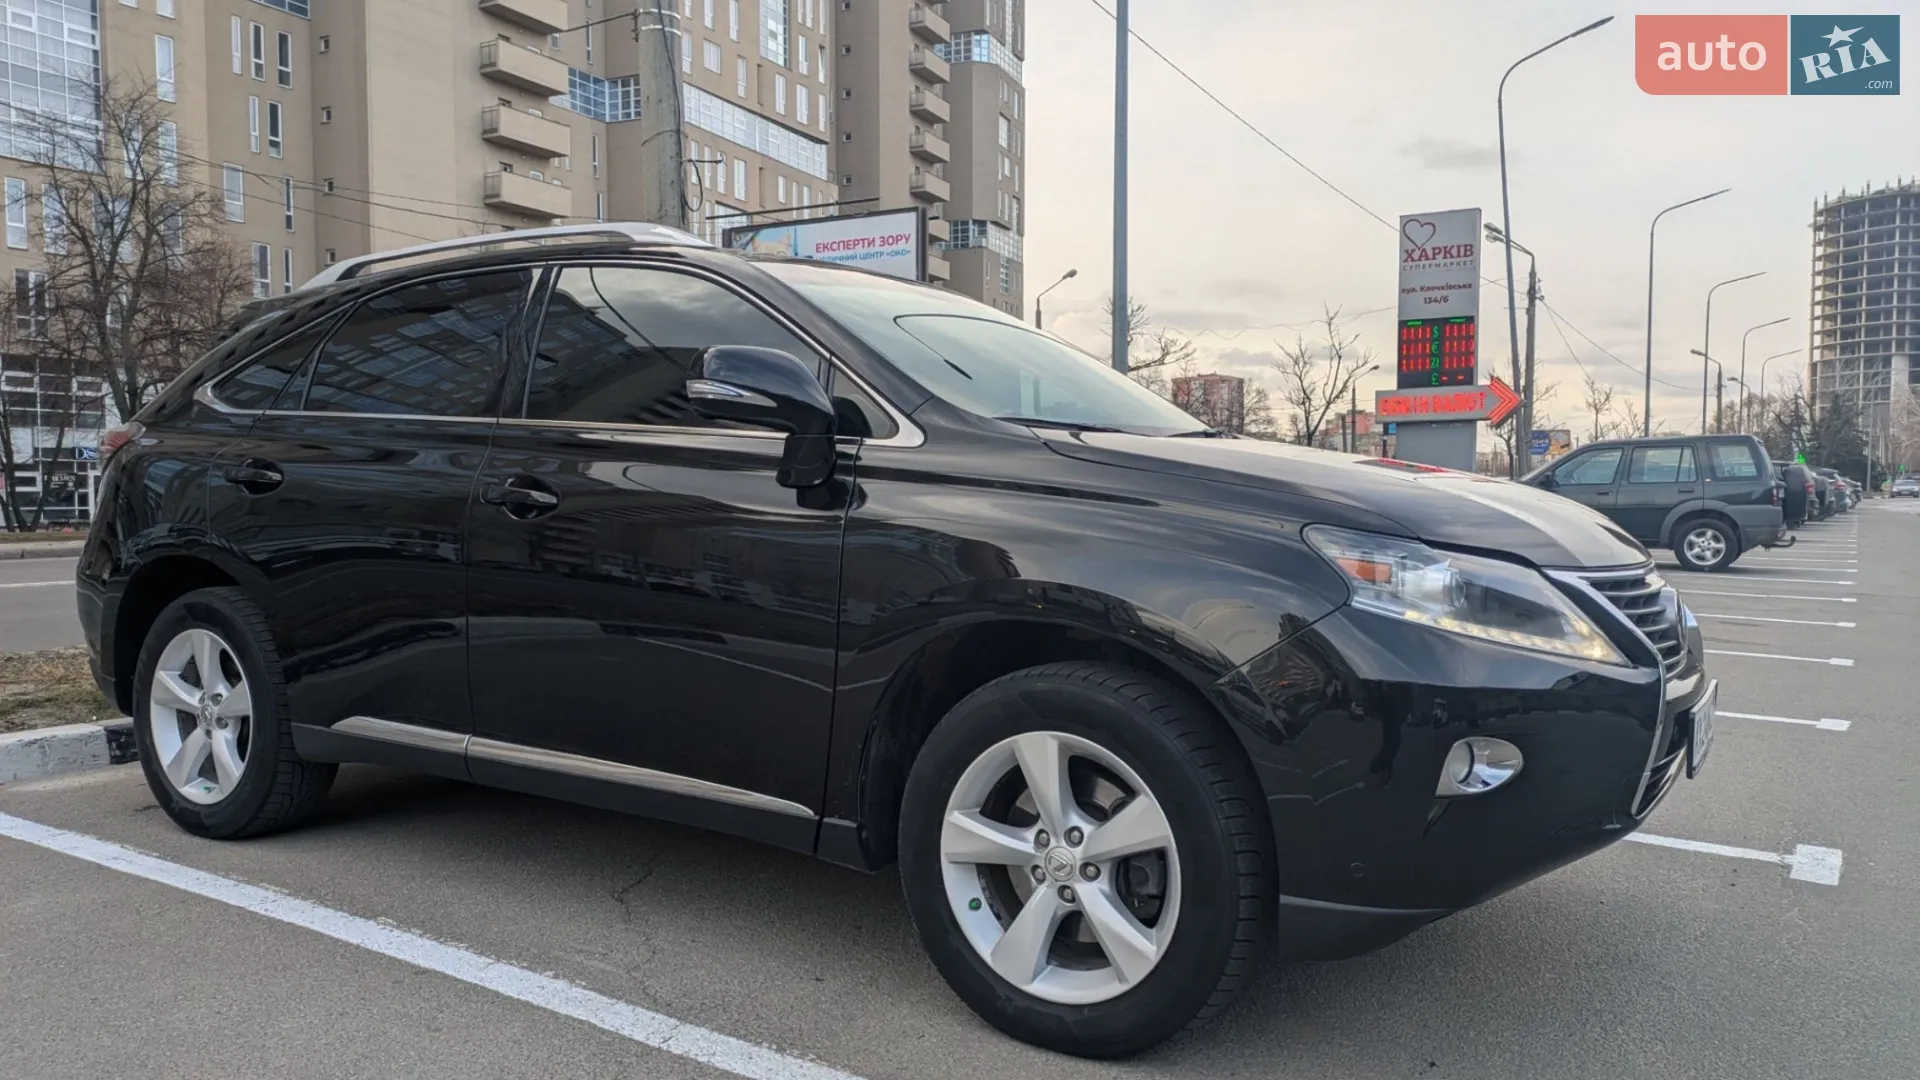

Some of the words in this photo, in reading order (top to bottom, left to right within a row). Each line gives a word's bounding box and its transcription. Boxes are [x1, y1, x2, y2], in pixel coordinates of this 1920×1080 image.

[815, 237, 875, 253] ЕКСПЕРТИ
[878, 233, 911, 247] ЗОРУ
[859, 250, 884, 261] ЦЕНТР
[1403, 244, 1473, 262] ХАРКІВ
[1403, 260, 1473, 271] СУПЕРМАРКЕТ
